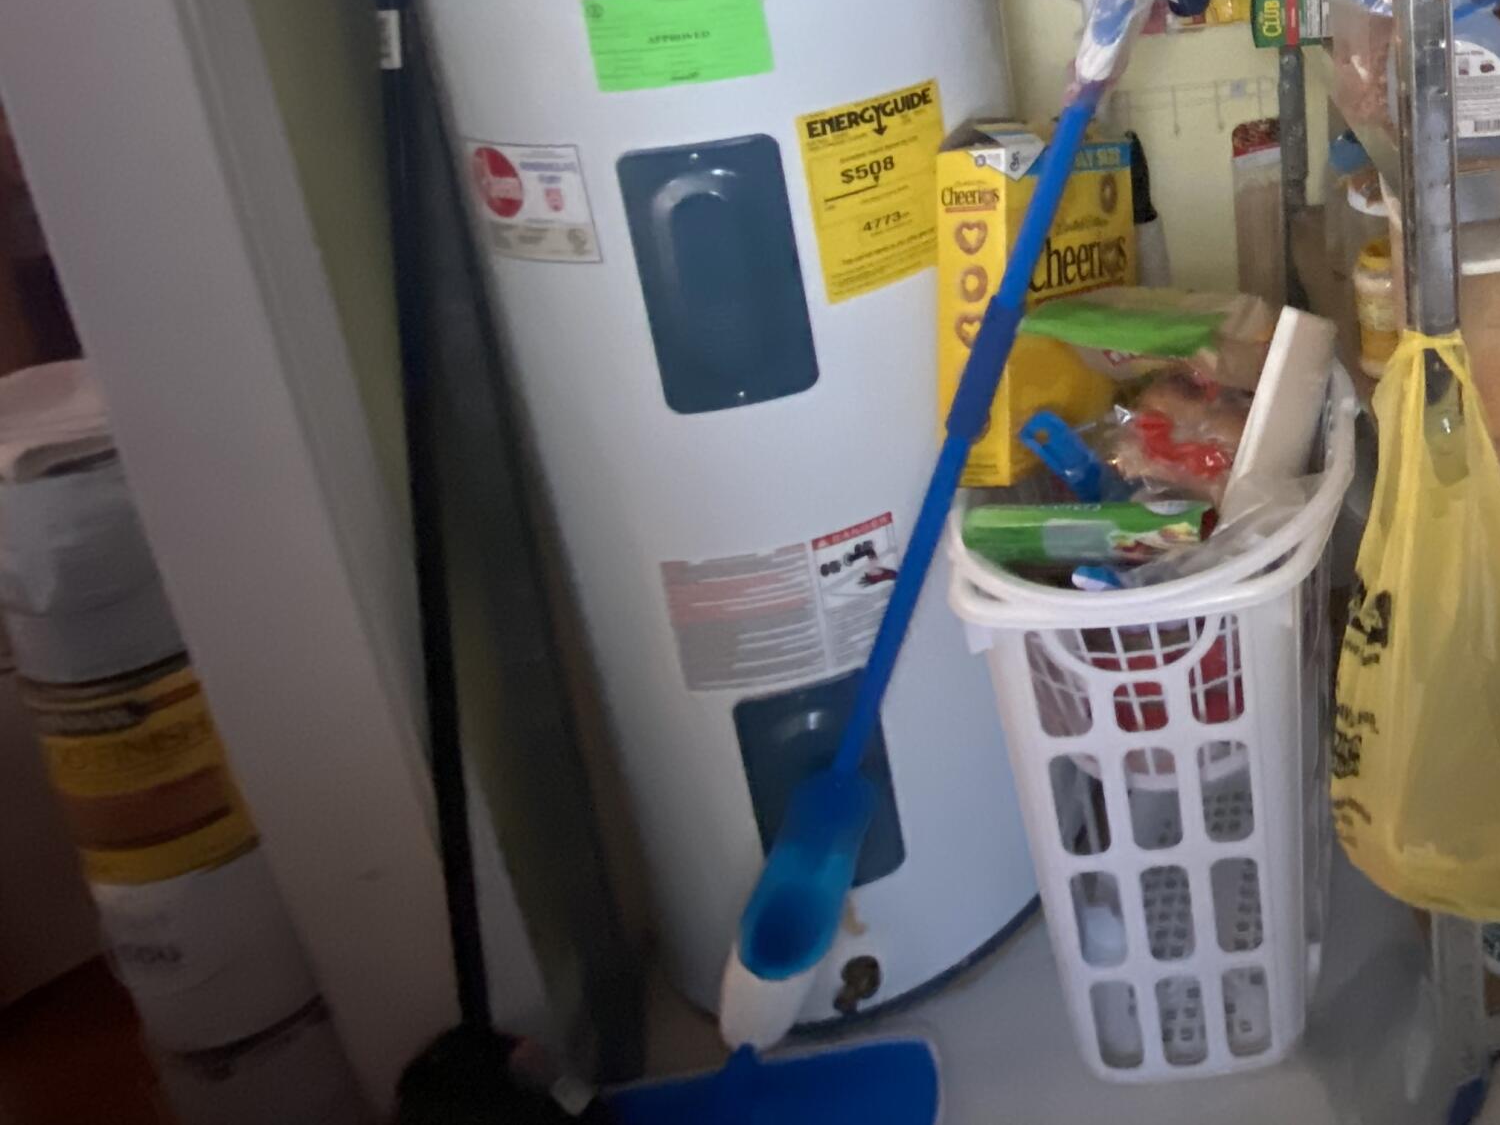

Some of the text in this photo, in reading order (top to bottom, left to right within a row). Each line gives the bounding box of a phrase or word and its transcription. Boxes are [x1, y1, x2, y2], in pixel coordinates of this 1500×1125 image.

[647, 30, 712, 45] APPROVED
[840, 155, 896, 185] $508
[940, 184, 1000, 209] Cheerios
